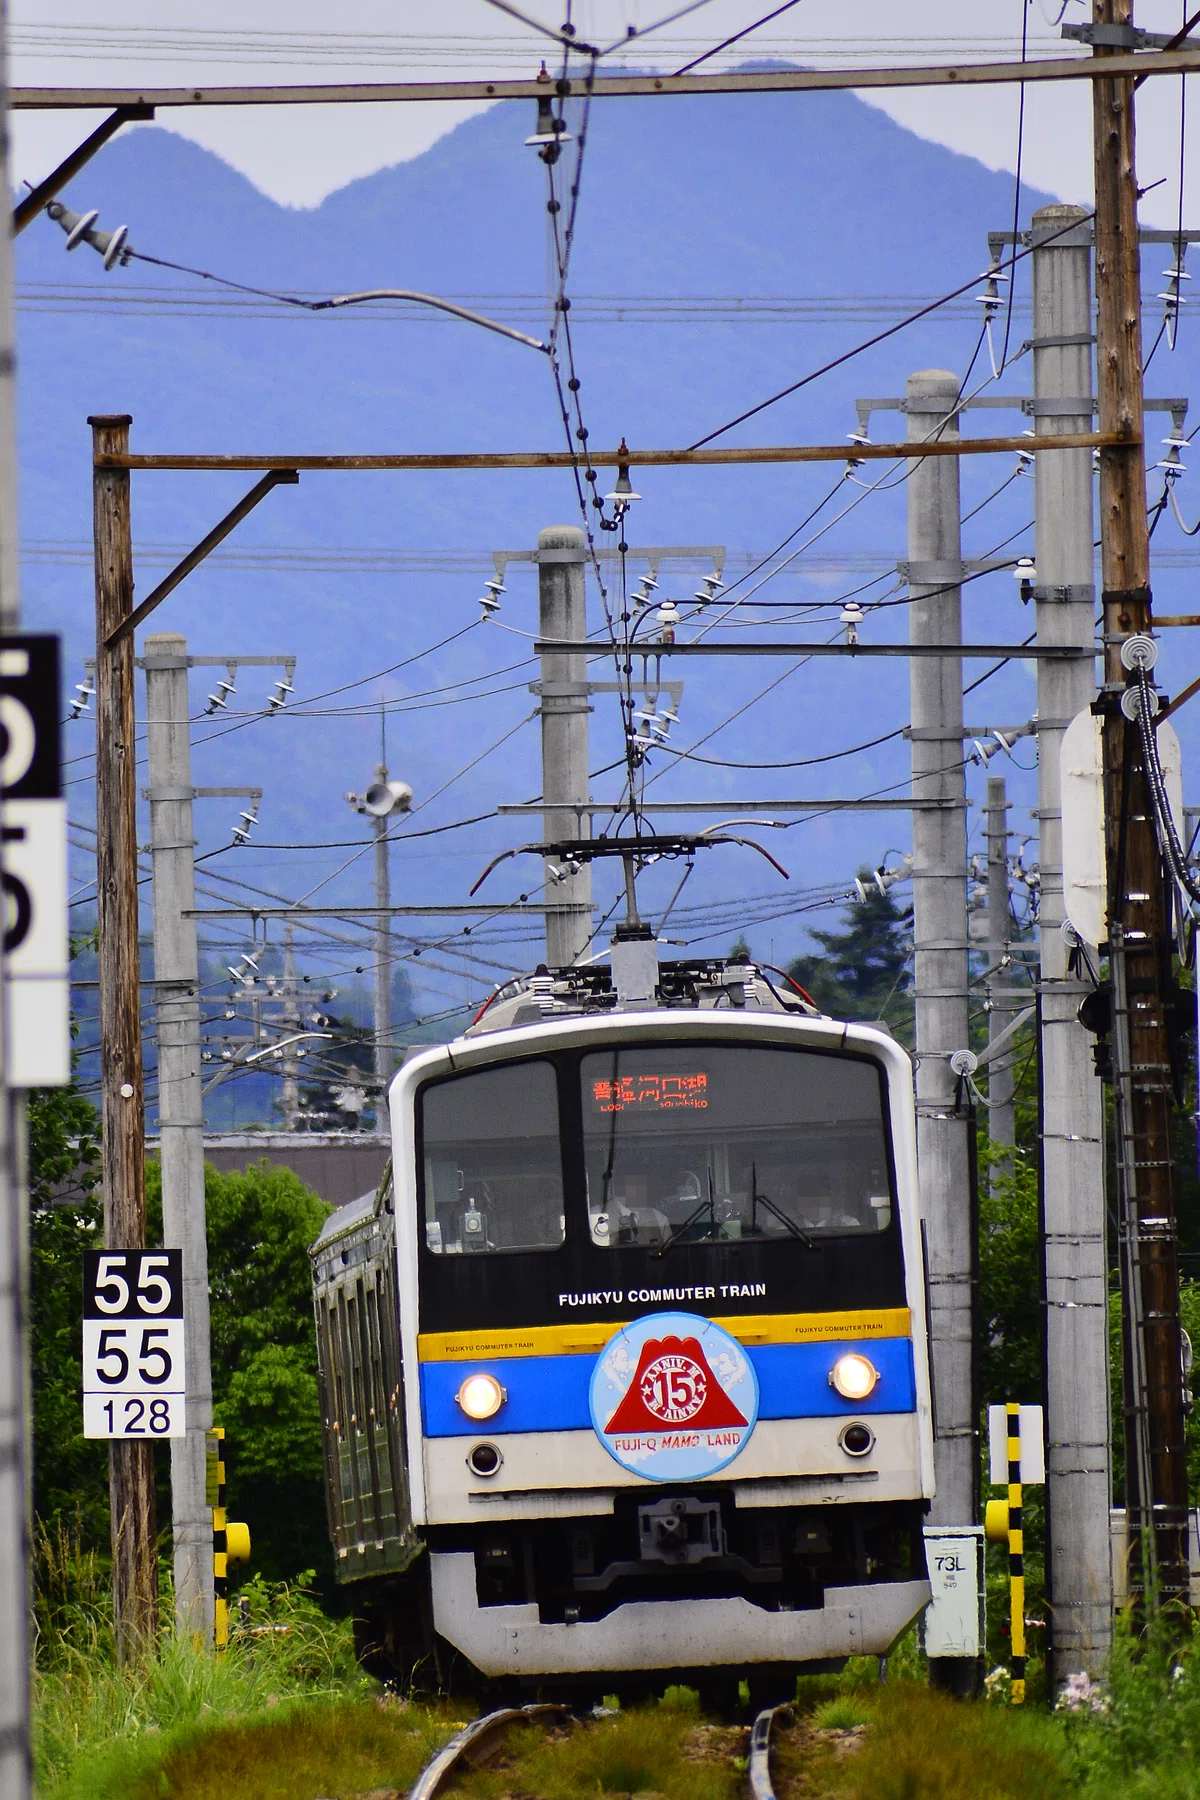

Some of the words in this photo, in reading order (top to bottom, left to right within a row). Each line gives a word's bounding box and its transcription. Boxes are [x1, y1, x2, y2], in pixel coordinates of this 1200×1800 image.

[94, 1256, 172, 1314] 55
[558, 1291, 623, 1306] FUJIKYU
[628, 1286, 716, 1303] COMMUTER
[720, 1283, 766, 1298] TRAIN
[824, 1324, 862, 1332] COMMUTER
[96, 1329, 172, 1385] 55
[445, 1345, 474, 1353] FUJIKYU
[475, 1343, 513, 1351] COMMUTER
[656, 1370, 693, 1409] 15
[103, 1399, 171, 1434] 128
[615, 1438, 657, 1451] FUJI-Q
[707, 1432, 741, 1446] LAND
[934, 1556, 967, 1572] 73L
